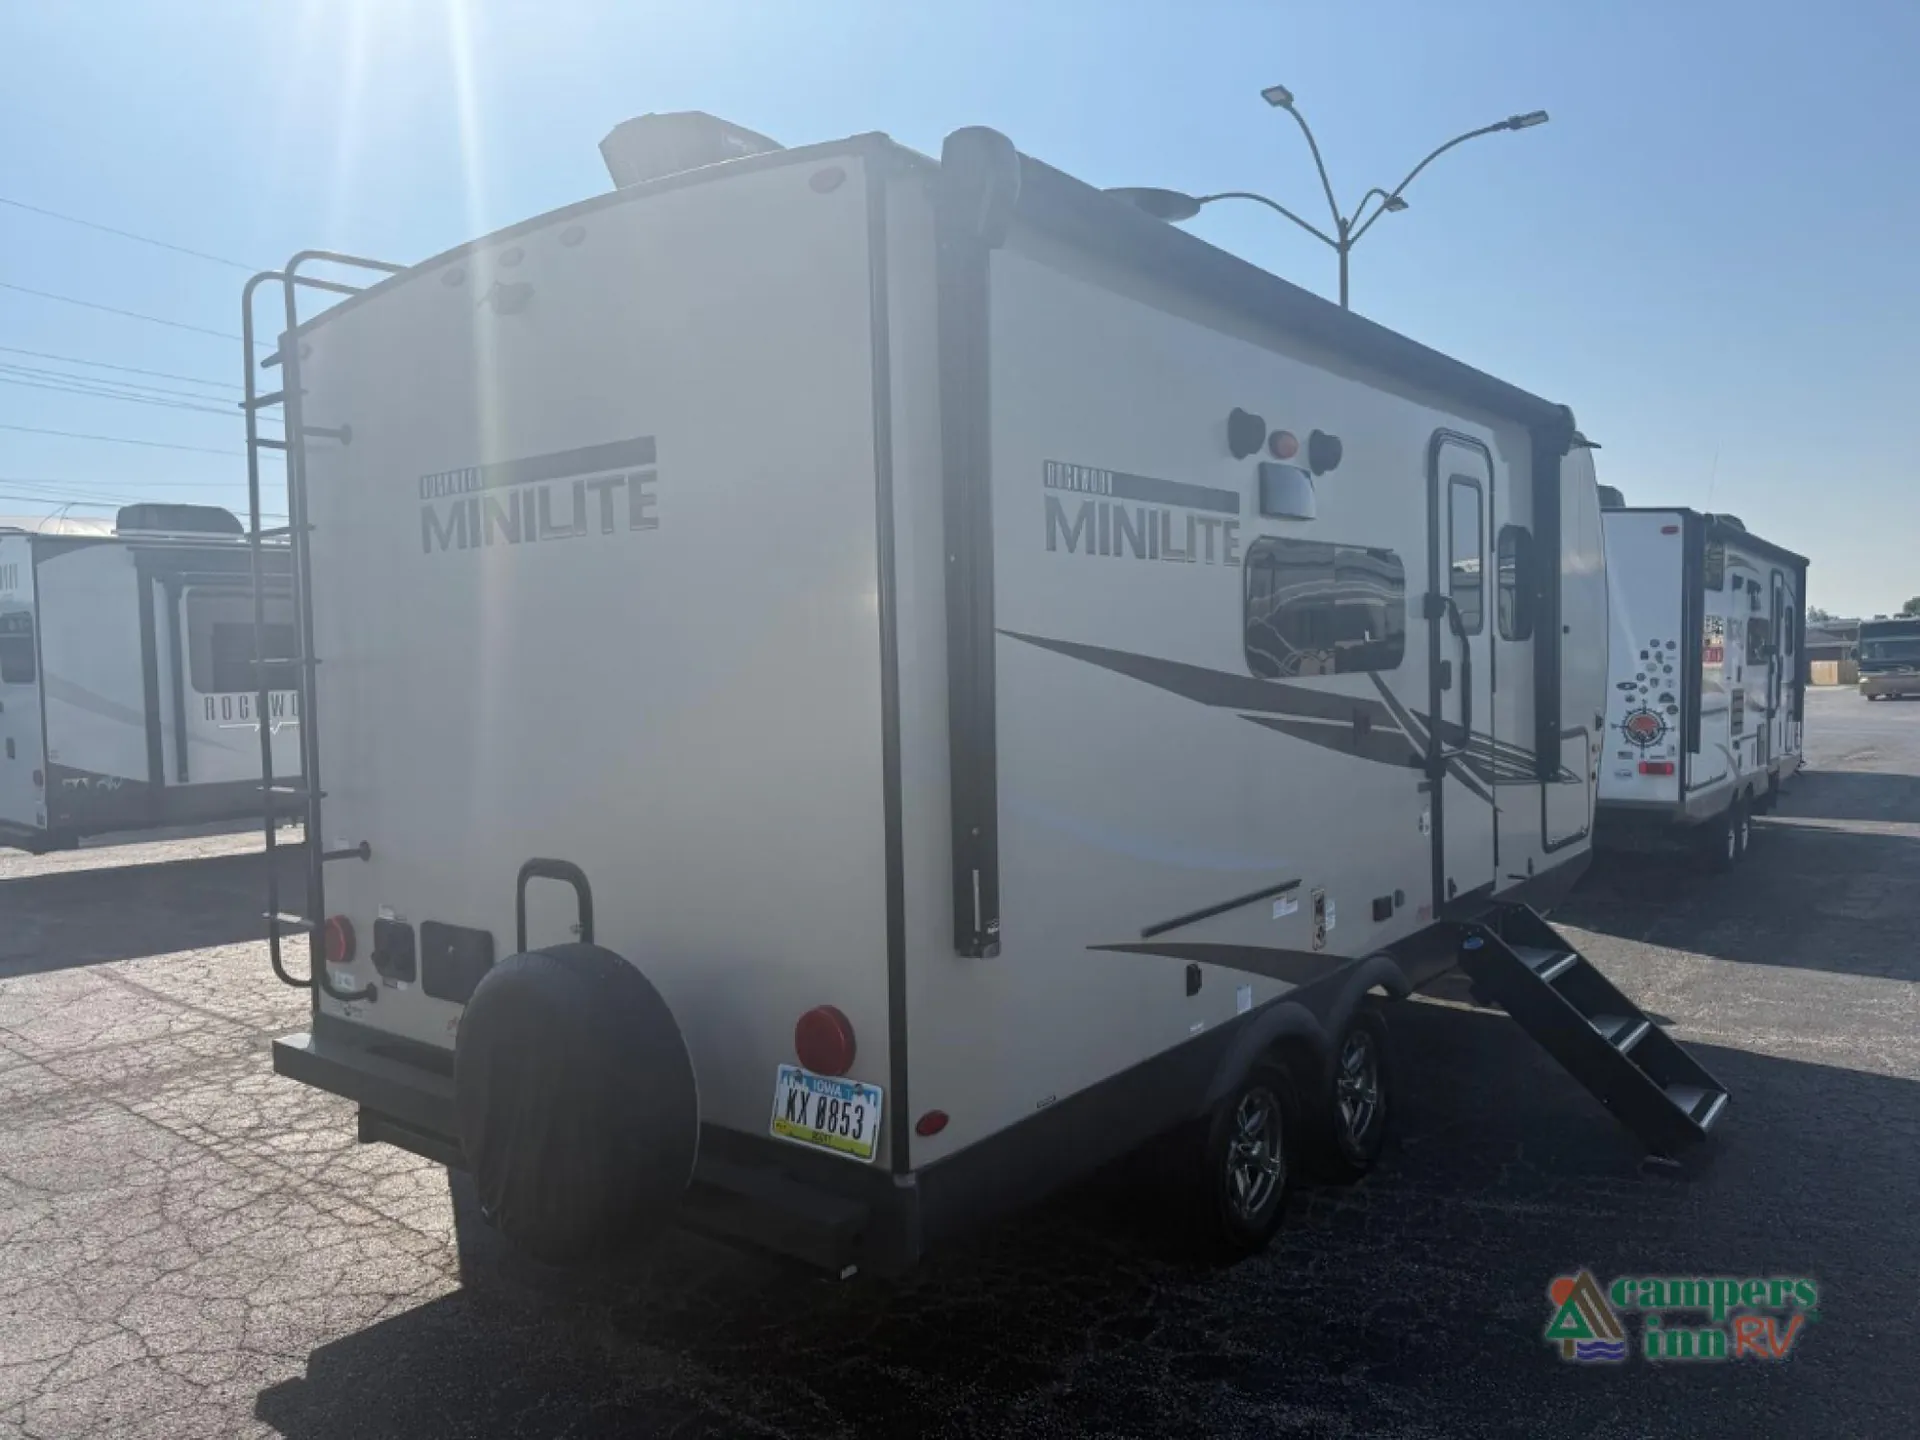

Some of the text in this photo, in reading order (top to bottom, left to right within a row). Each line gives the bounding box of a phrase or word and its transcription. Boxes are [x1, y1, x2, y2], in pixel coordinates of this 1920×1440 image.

[420, 469, 659, 554] MINILITE
[1044, 493, 1240, 567] MINILITE
[786, 1088, 865, 1140] KX 0853
[813, 1079, 842, 1097] IOWA
